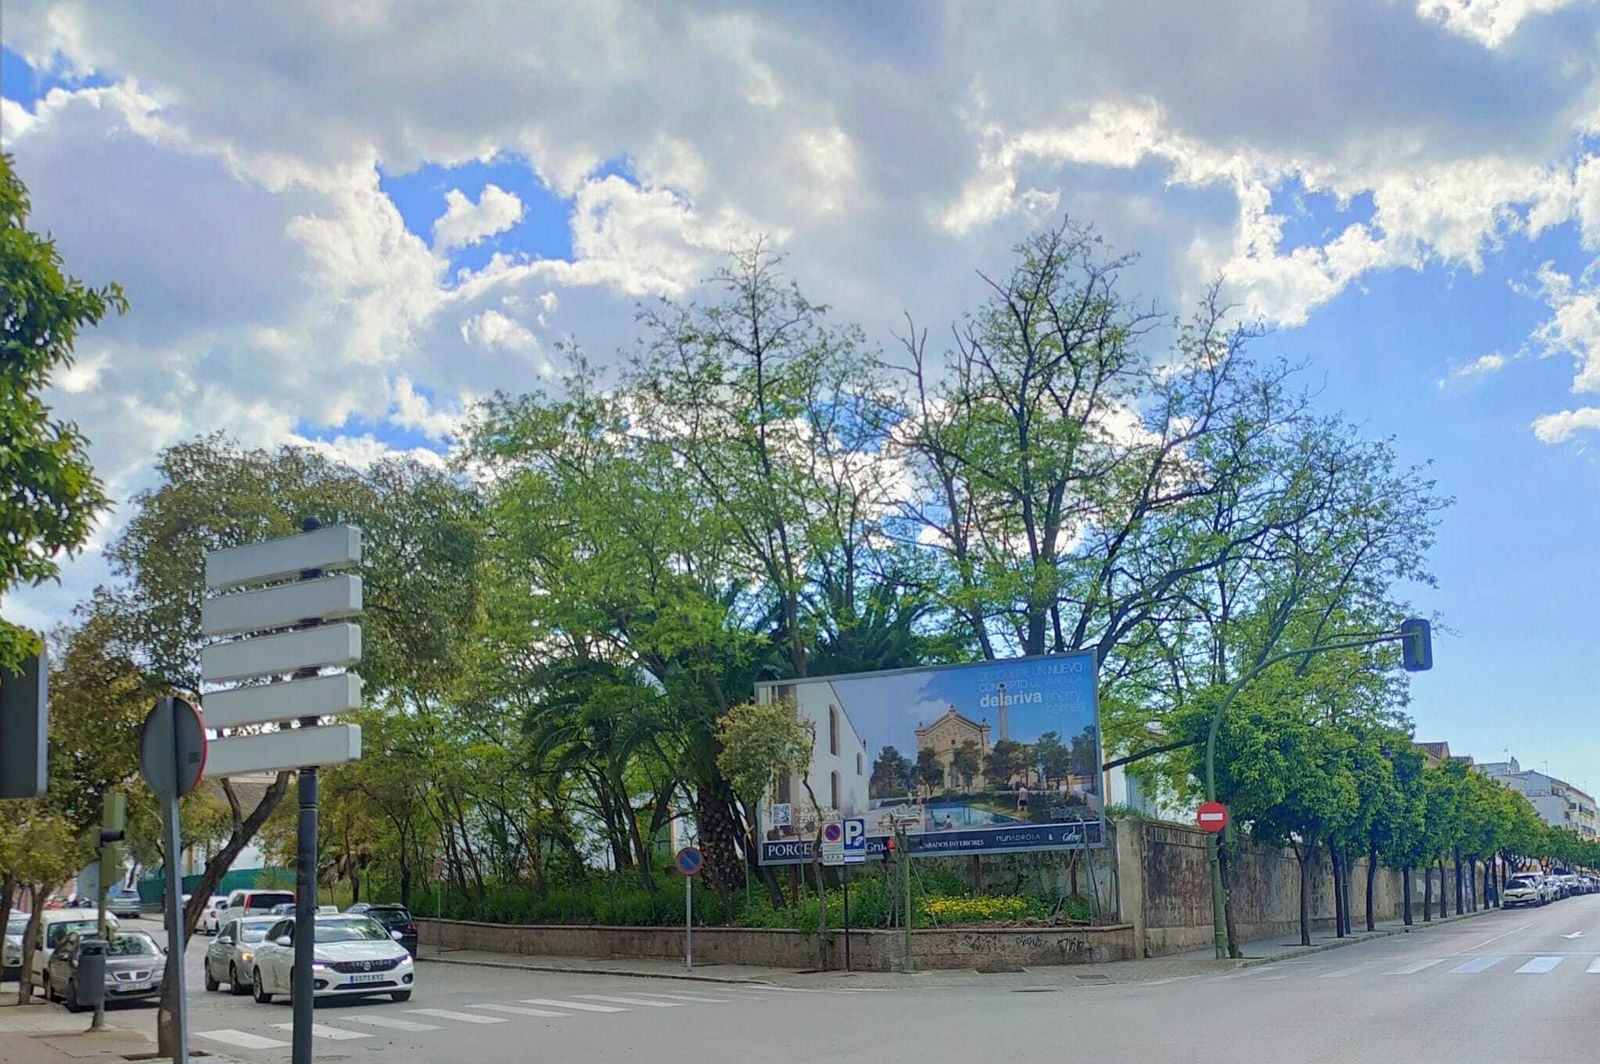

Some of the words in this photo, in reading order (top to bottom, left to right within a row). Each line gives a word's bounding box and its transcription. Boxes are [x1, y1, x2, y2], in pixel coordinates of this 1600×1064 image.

[1048, 663, 1083, 674] NUEVO
[980, 690, 1043, 708] delariva
[844, 821, 863, 846] P
